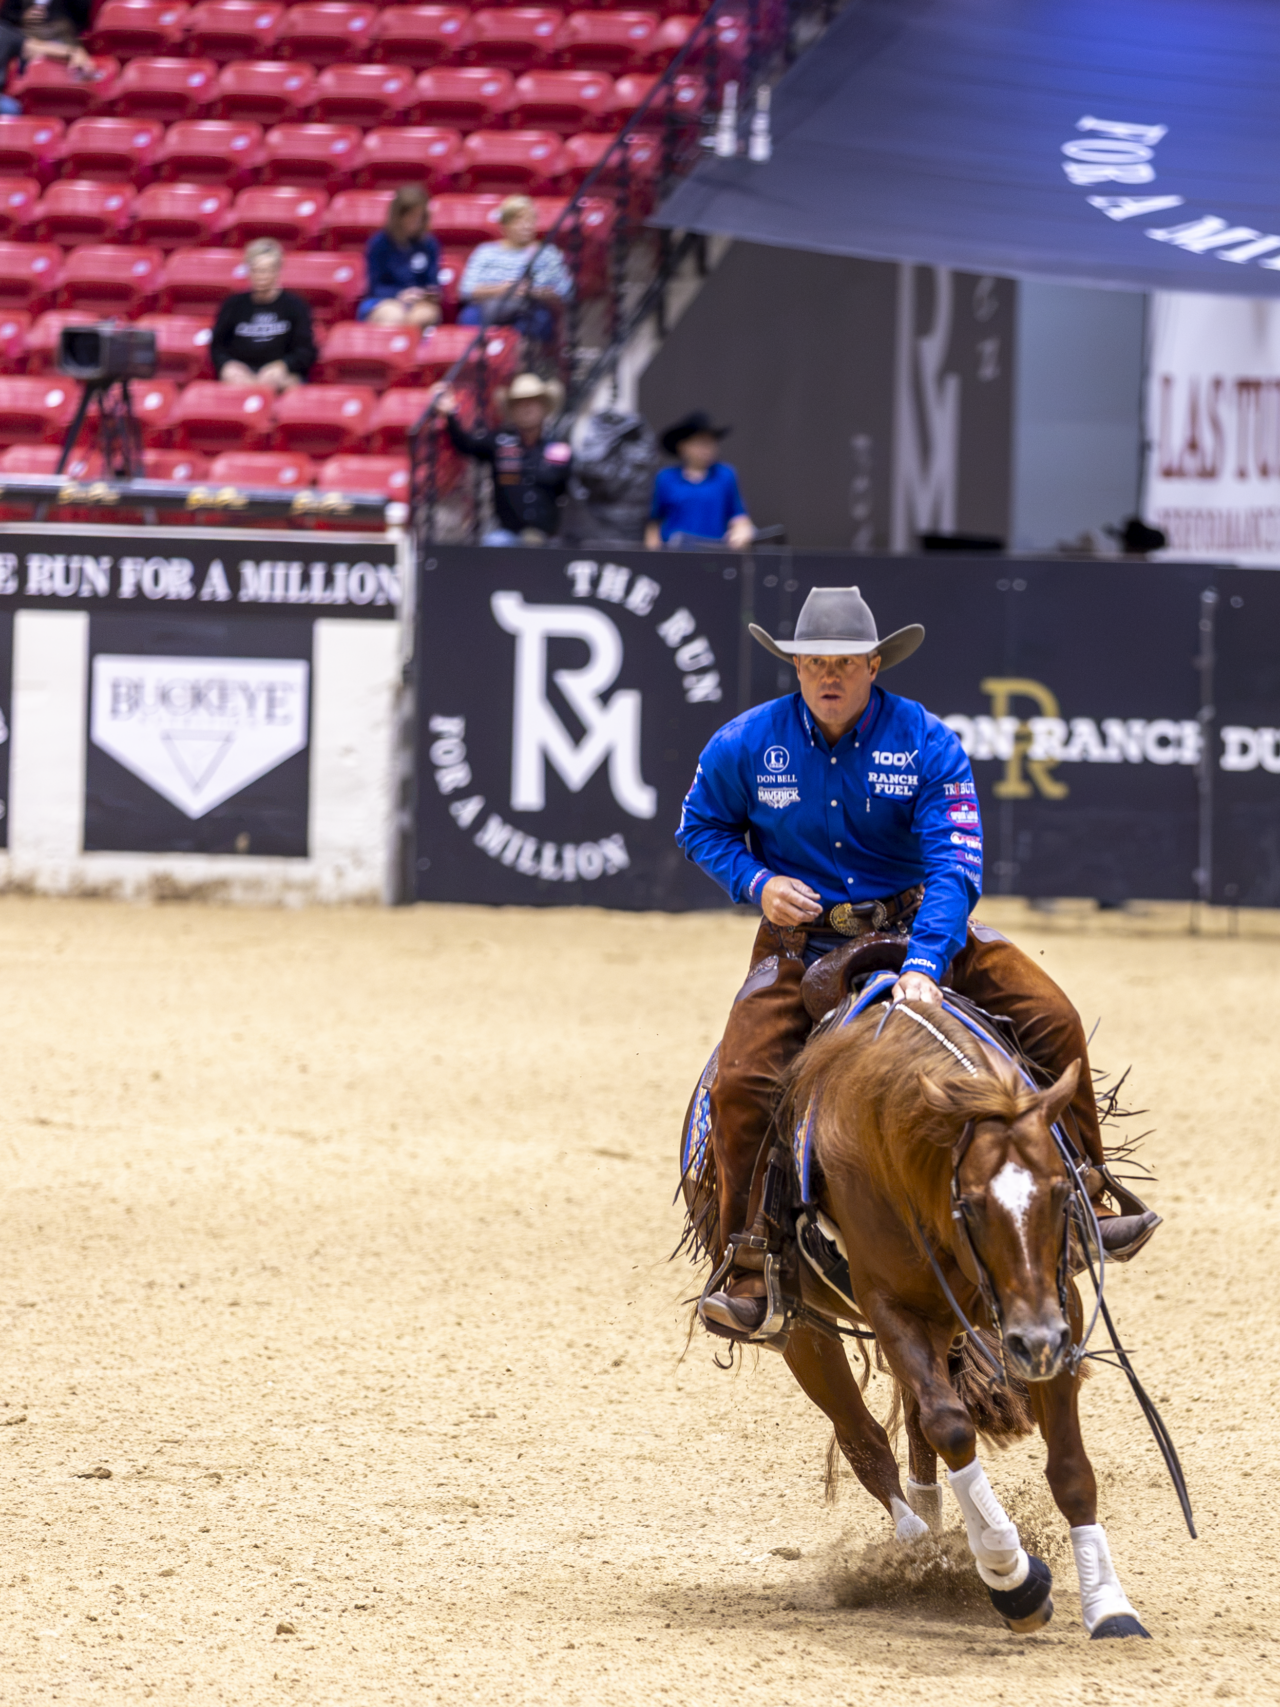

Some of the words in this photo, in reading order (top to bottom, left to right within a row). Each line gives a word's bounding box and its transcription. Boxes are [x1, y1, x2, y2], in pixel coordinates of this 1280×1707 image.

[1061, 115, 1169, 186] FOR
[1086, 194, 1186, 221] A
[25, 554, 114, 598] RUN
[117, 556, 197, 600] FOR
[201, 558, 232, 602] A
[238, 559, 403, 606] MILLION
[564, 560, 661, 616] THE
[657, 607, 722, 702] RUN
[108, 676, 296, 727] BUCKEYE
[429, 714, 472, 795] FOR
[756, 774, 776, 784] DON
[777, 774, 798, 783] BELL
[868, 771, 919, 786] RANCH
[874, 783, 913, 797] FUEL
[943, 781, 976, 796] TRIBUT
[449, 794, 486, 830] A
[473, 813, 630, 882] MILLION
